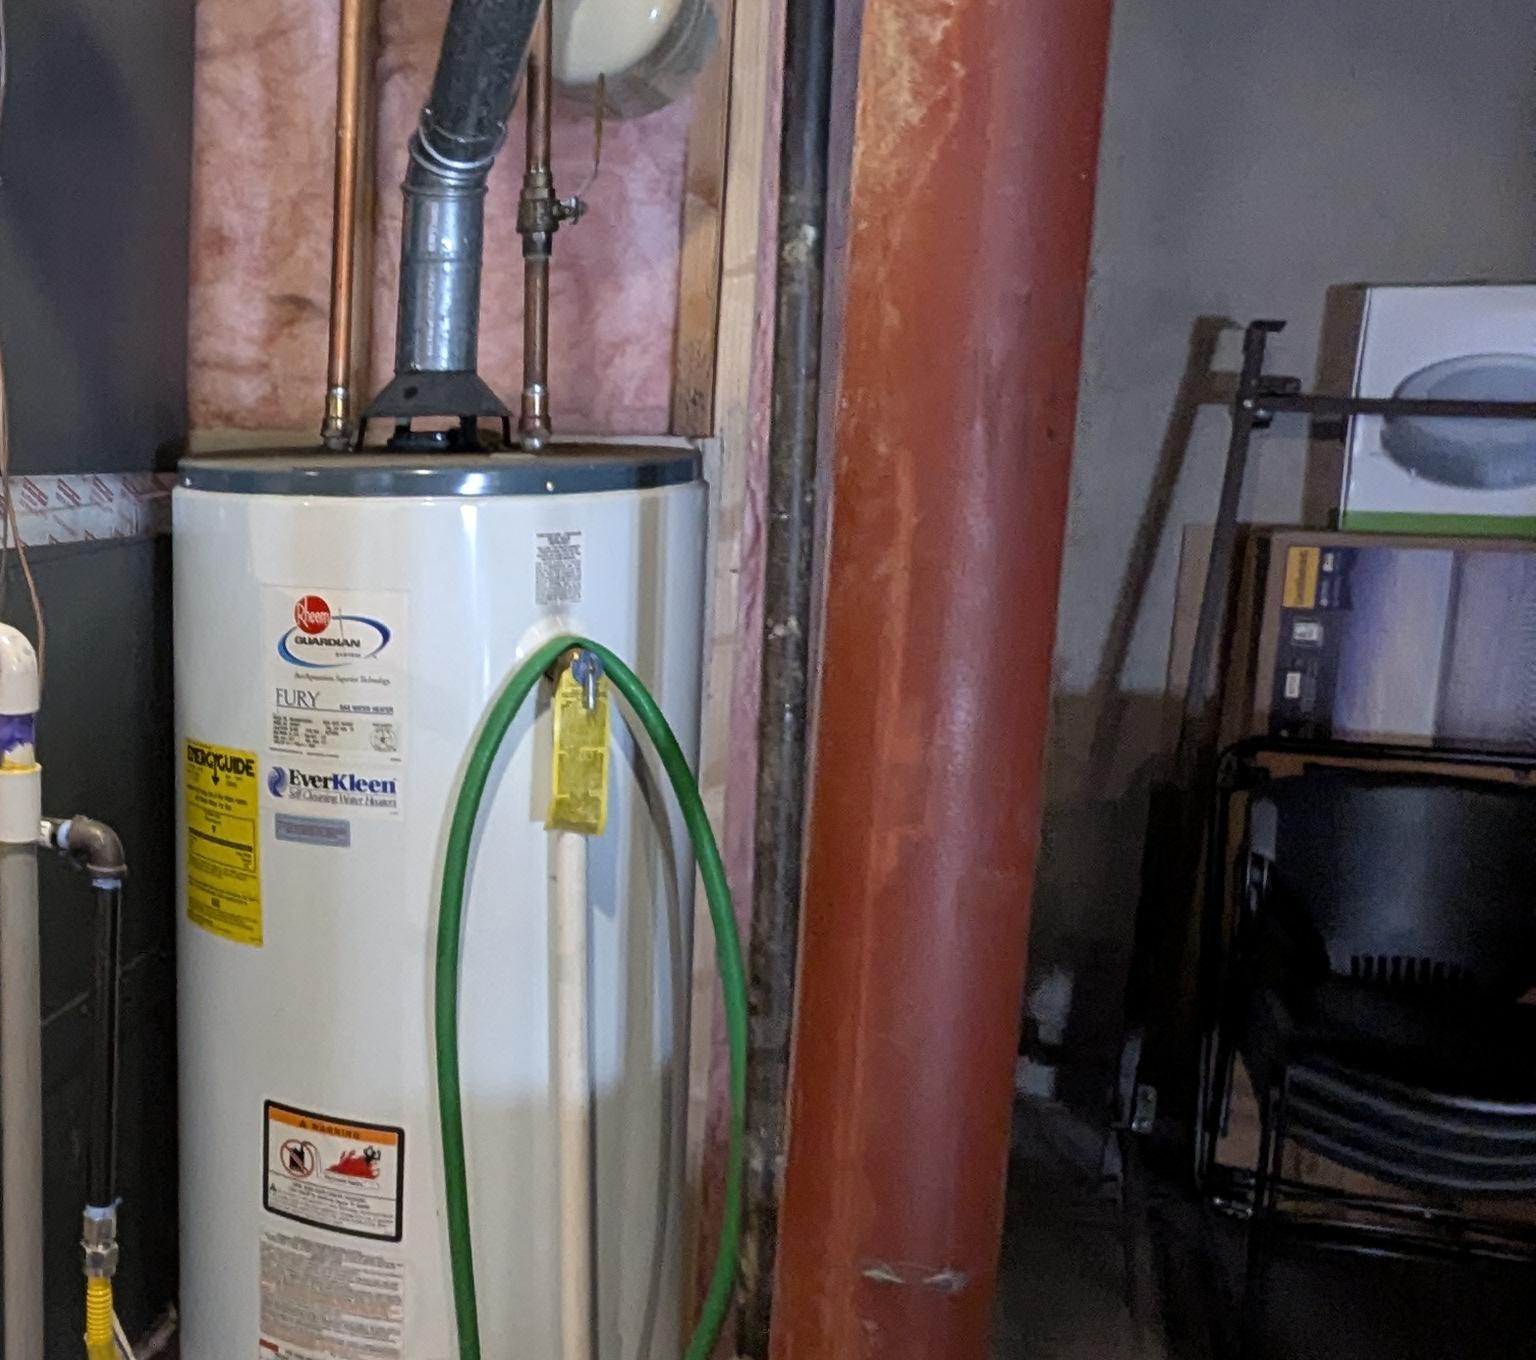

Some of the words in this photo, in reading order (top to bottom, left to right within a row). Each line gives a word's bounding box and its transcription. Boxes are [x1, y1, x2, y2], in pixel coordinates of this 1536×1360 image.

[295, 596, 330, 629] Rheem
[294, 636, 361, 648] GUARDIAN
[275, 687, 320, 708] FURY
[288, 768, 397, 794] EverKleen
[311, 1122, 361, 1140] WARNING
